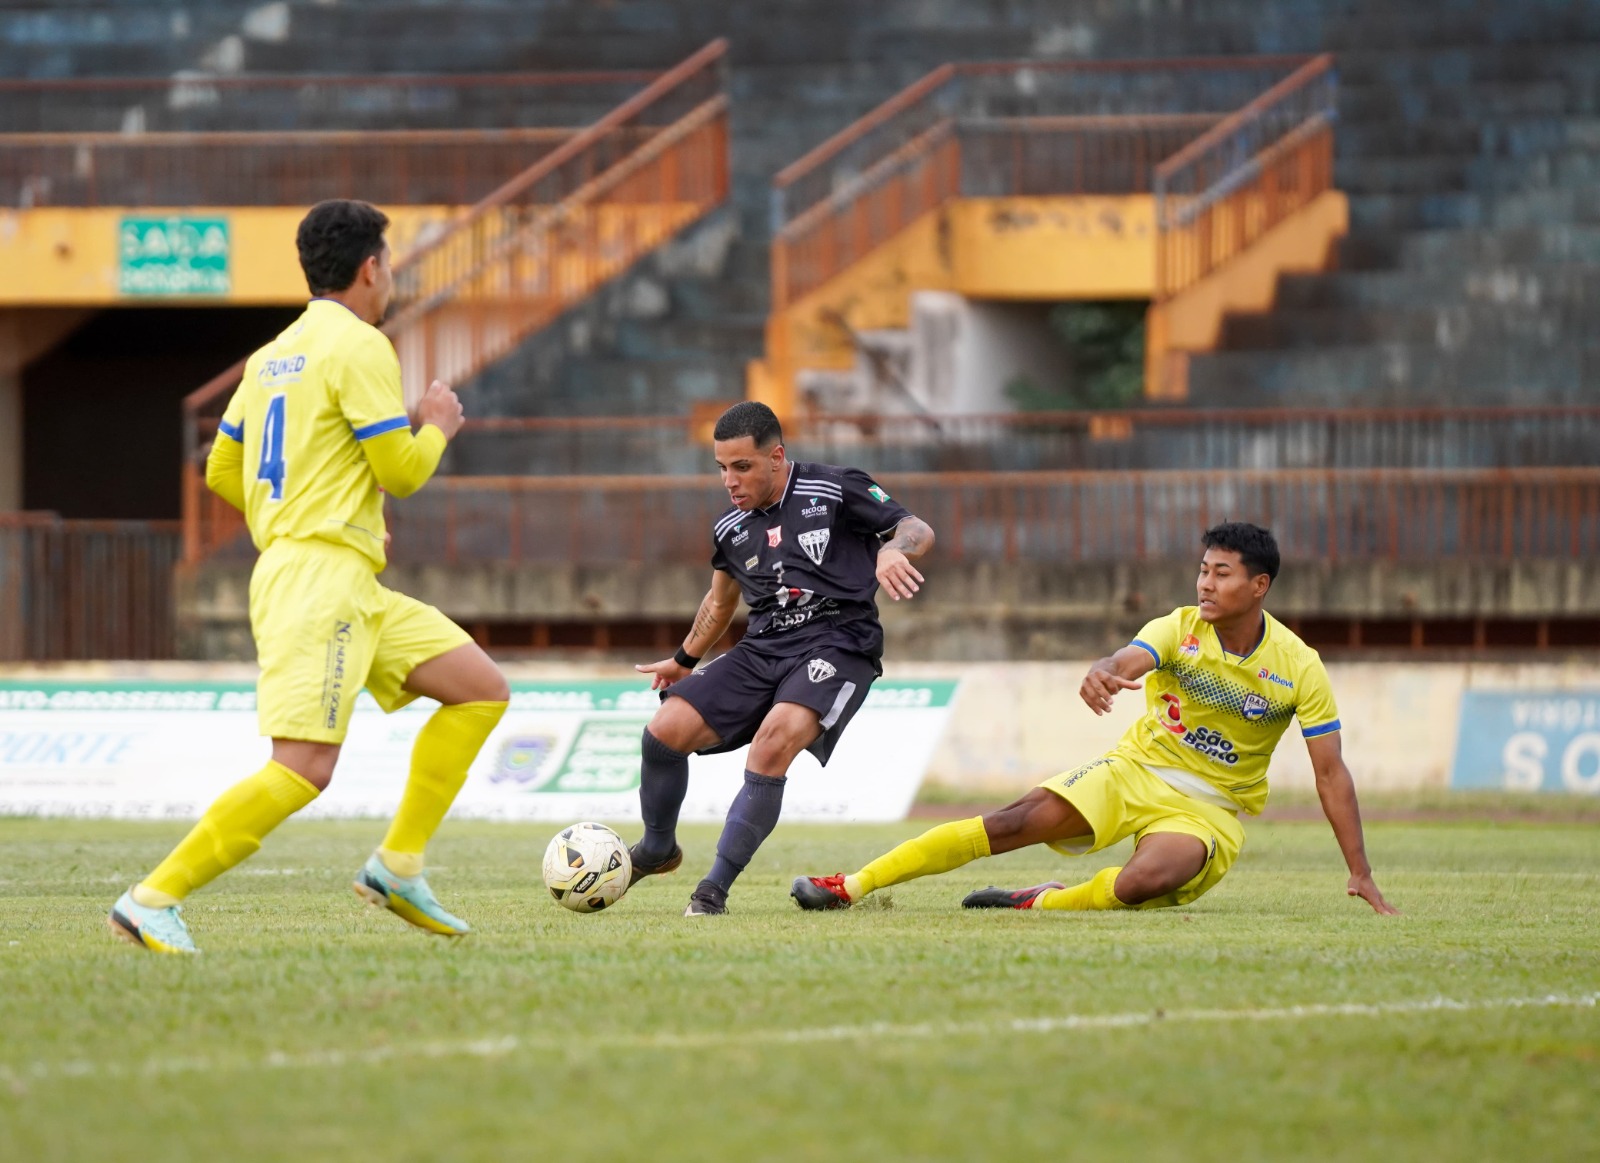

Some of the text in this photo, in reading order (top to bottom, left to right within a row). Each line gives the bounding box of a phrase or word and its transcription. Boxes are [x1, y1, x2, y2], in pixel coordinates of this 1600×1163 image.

[257, 393, 286, 501] 4
[801, 504, 828, 516] SICOOB
[1195, 726, 1233, 752] São
